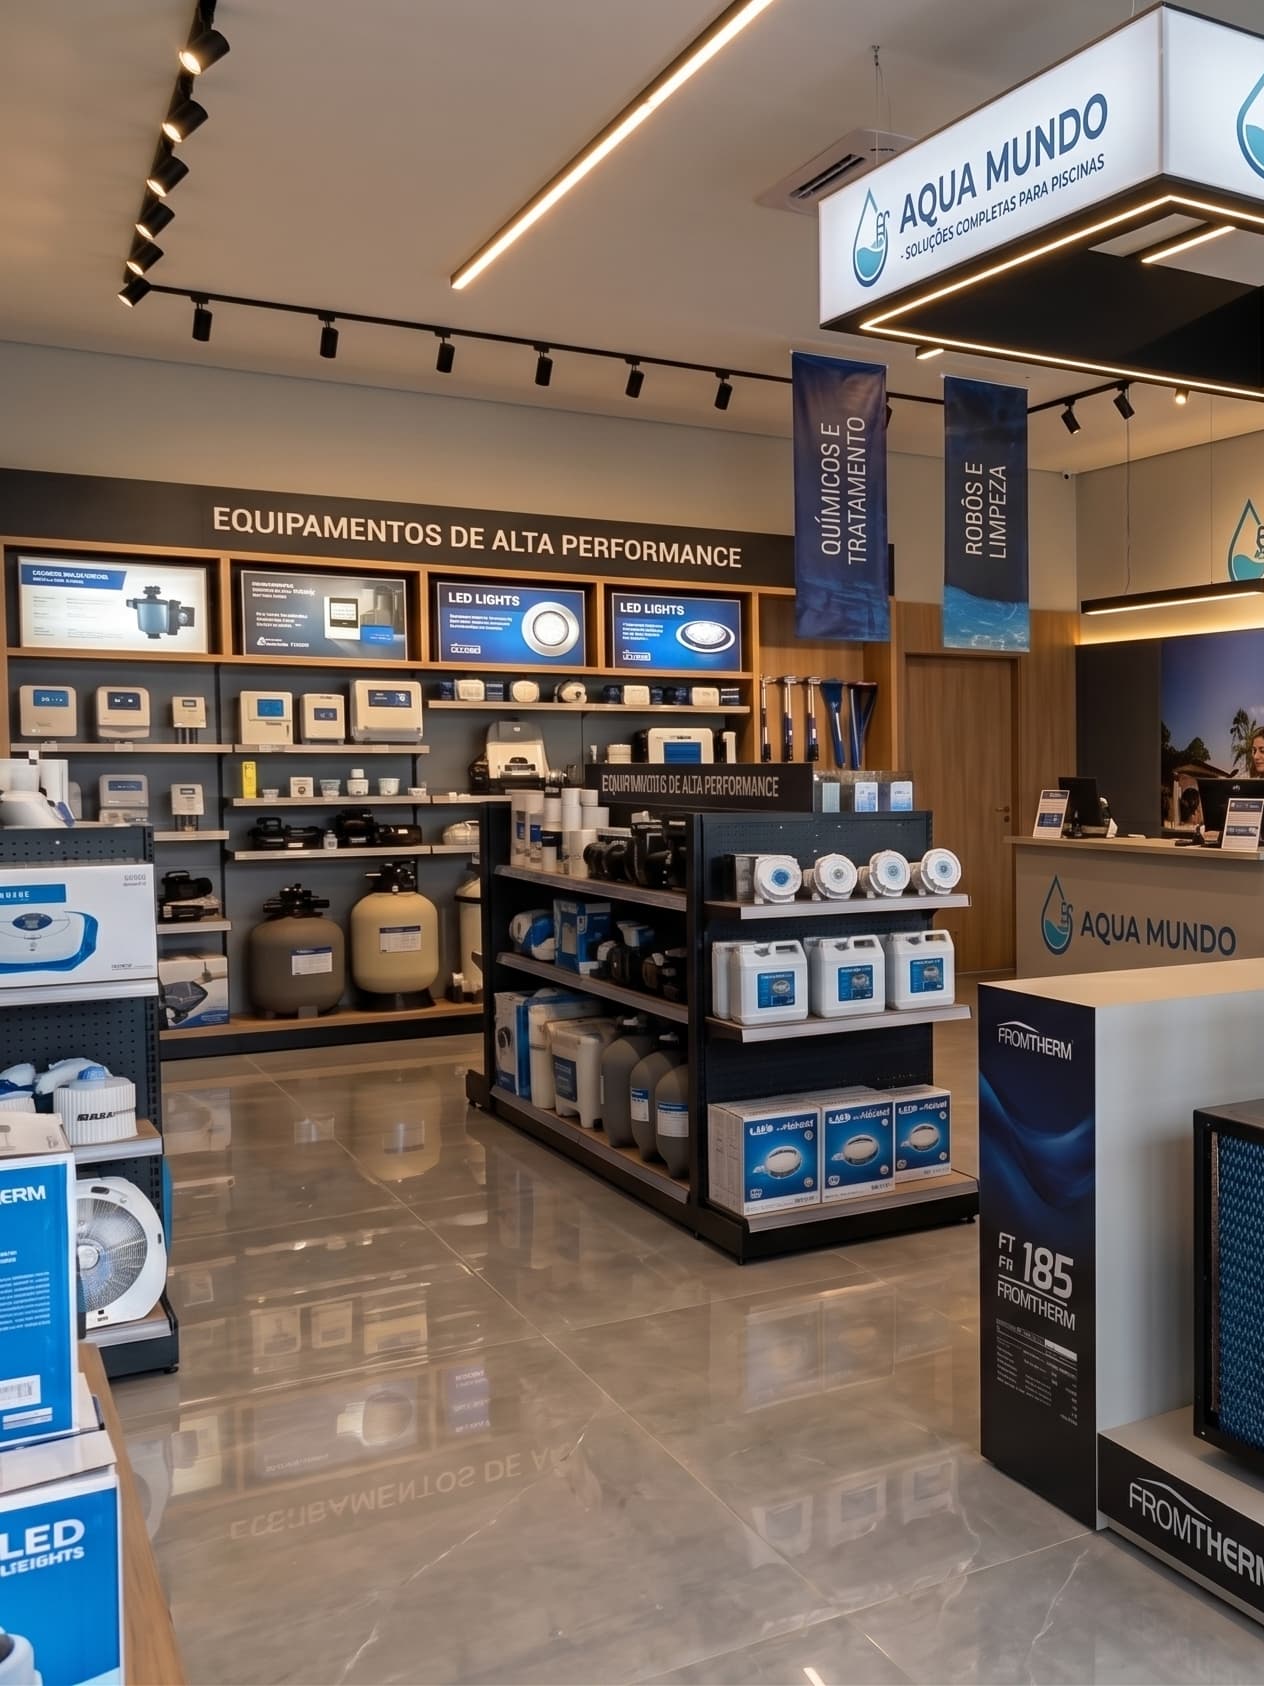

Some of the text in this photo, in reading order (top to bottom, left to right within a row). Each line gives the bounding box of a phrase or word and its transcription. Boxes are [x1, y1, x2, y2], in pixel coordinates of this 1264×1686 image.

[899, 93, 1108, 233] AQUA MUNDO
[956, 195, 1016, 236] COMPLETAS
[1019, 181, 1049, 208] PARA
[1051, 153, 1105, 192] PISCINAS
[814, 423, 841, 555] QUÍMICOS E
[846, 417, 867, 565] TRATAMENTO
[961, 461, 983, 556] ROBÔS E
[989, 465, 1007, 559] LIMPEZA
[213, 506, 743, 568] EQUIPAMENTOS DE ALTA PERFORMANCE
[448, 592, 520, 607] LED LIGHTS
[620, 602, 685, 616] LED LIGHTS
[669, 775, 681, 794] DE
[682, 775, 703, 794] ALTA
[705, 776, 779, 798] PERFORMANCE
[1081, 911, 1237, 956] AQUA MUNDO
[998, 1027, 1072, 1061] FROMTHERM
[0, 1185, 46, 1205] ERM
[998, 1232, 1016, 1253] FT
[1023, 1242, 1074, 1299] 185
[997, 1280, 1075, 1332] FROMTHERM
[0, 1519, 85, 1561] LED
